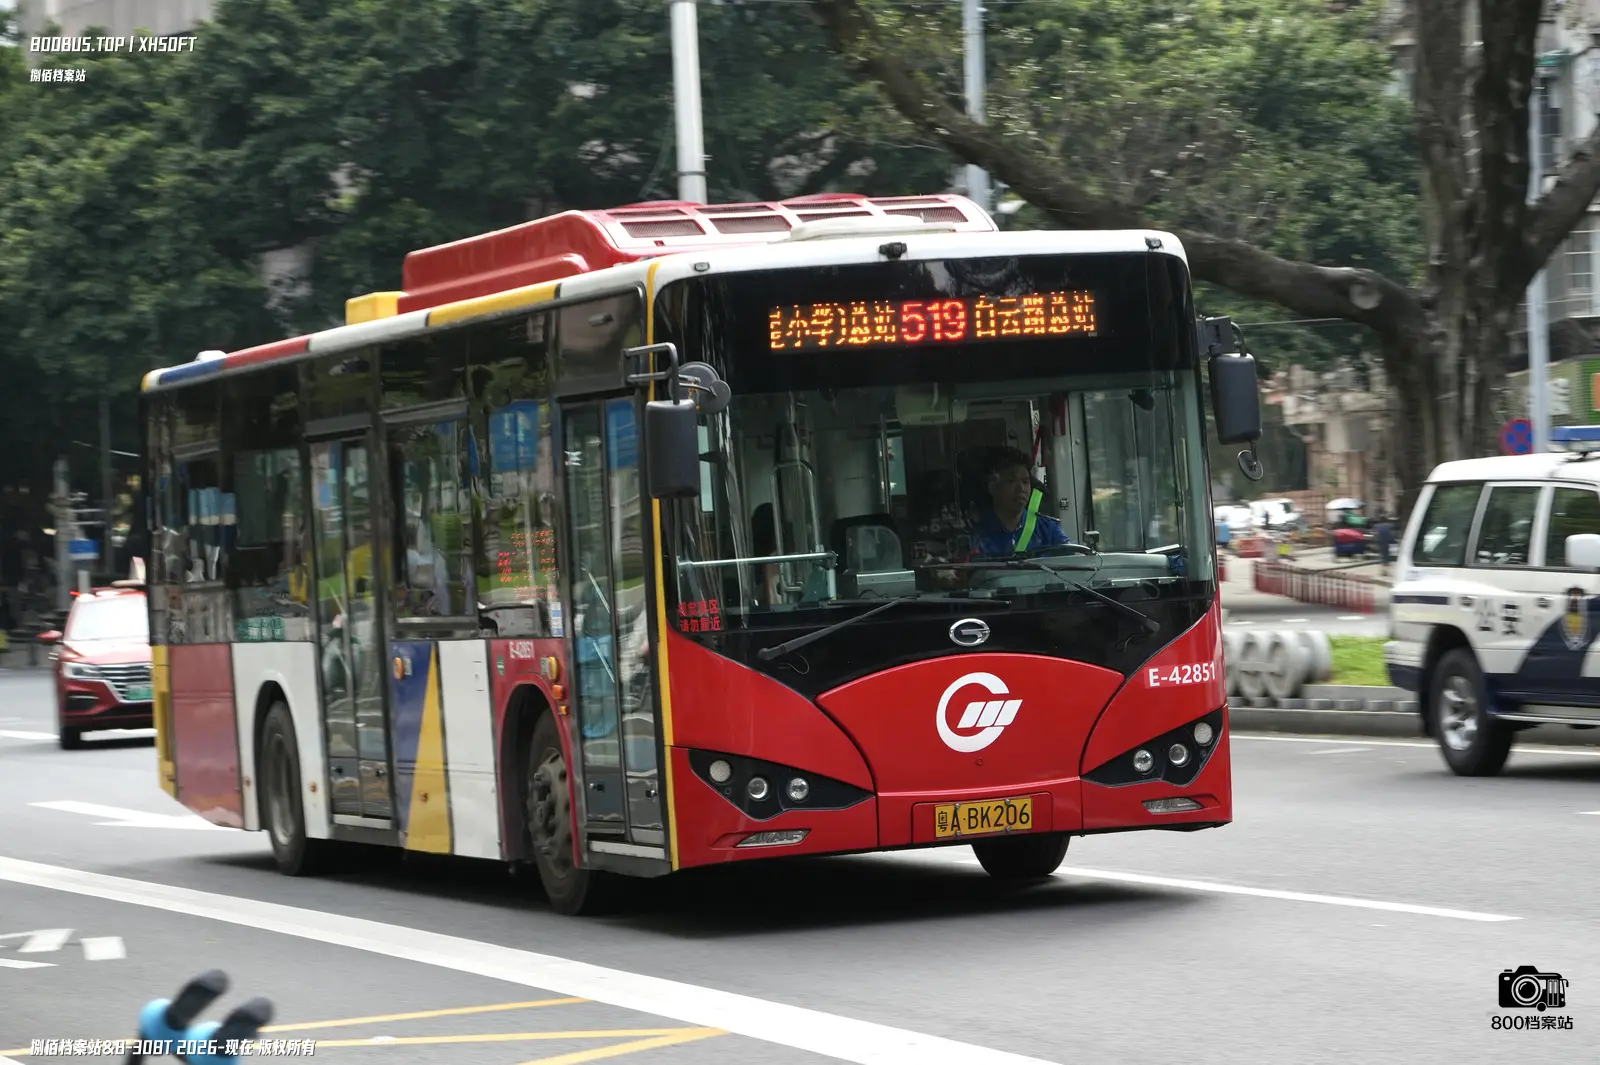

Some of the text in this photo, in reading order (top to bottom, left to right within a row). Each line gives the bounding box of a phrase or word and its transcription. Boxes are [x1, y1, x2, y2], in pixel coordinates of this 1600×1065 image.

[902, 300, 967, 343] 519
[975, 290, 1096, 338] 白云路总站
[1148, 662, 1216, 687] E-42851
